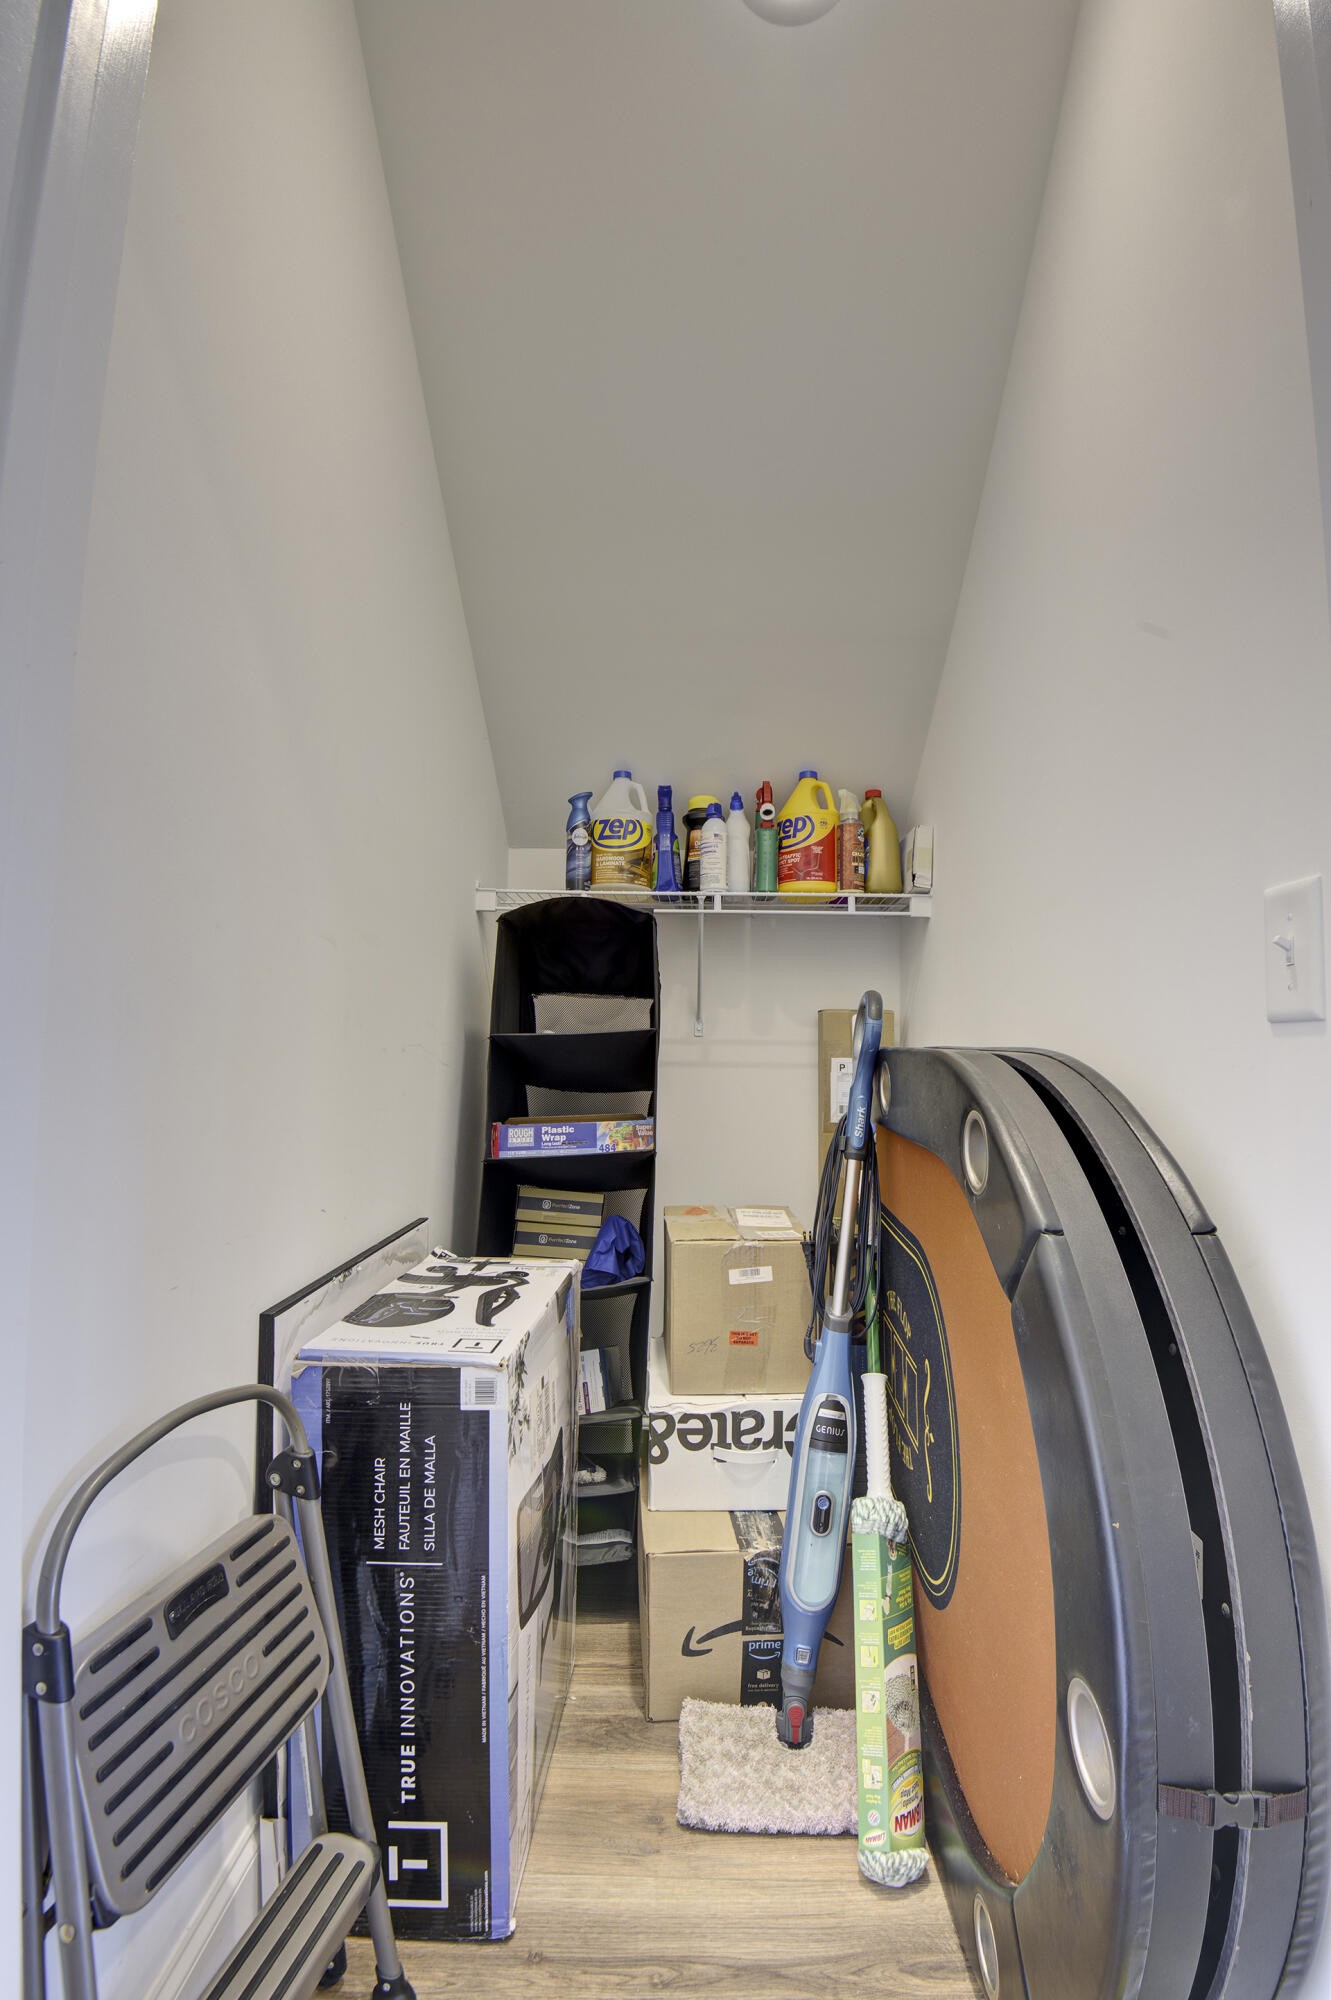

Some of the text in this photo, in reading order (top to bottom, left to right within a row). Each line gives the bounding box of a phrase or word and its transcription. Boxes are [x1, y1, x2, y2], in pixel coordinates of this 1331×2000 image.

[839, 1063, 846, 1072] P
[854, 1106, 866, 1138] Shark
[509, 1128, 534, 1138] ROUGH
[541, 1125, 575, 1134] Plastic
[541, 1134, 567, 1143] Wrap
[599, 1143, 617, 1153] 484
[815, 1424, 846, 1437] GENIUS
[398, 1402, 411, 1551] FAUTEUIL EN MAILLE
[423, 1434, 436, 1552] SILLA DE MALLA
[373, 1457, 386, 1550] MESH CHAIR
[748, 1639, 781, 1652] prime
[179, 1654, 259, 1742] COSCO
[400, 1744, 416, 1804] TRUE
